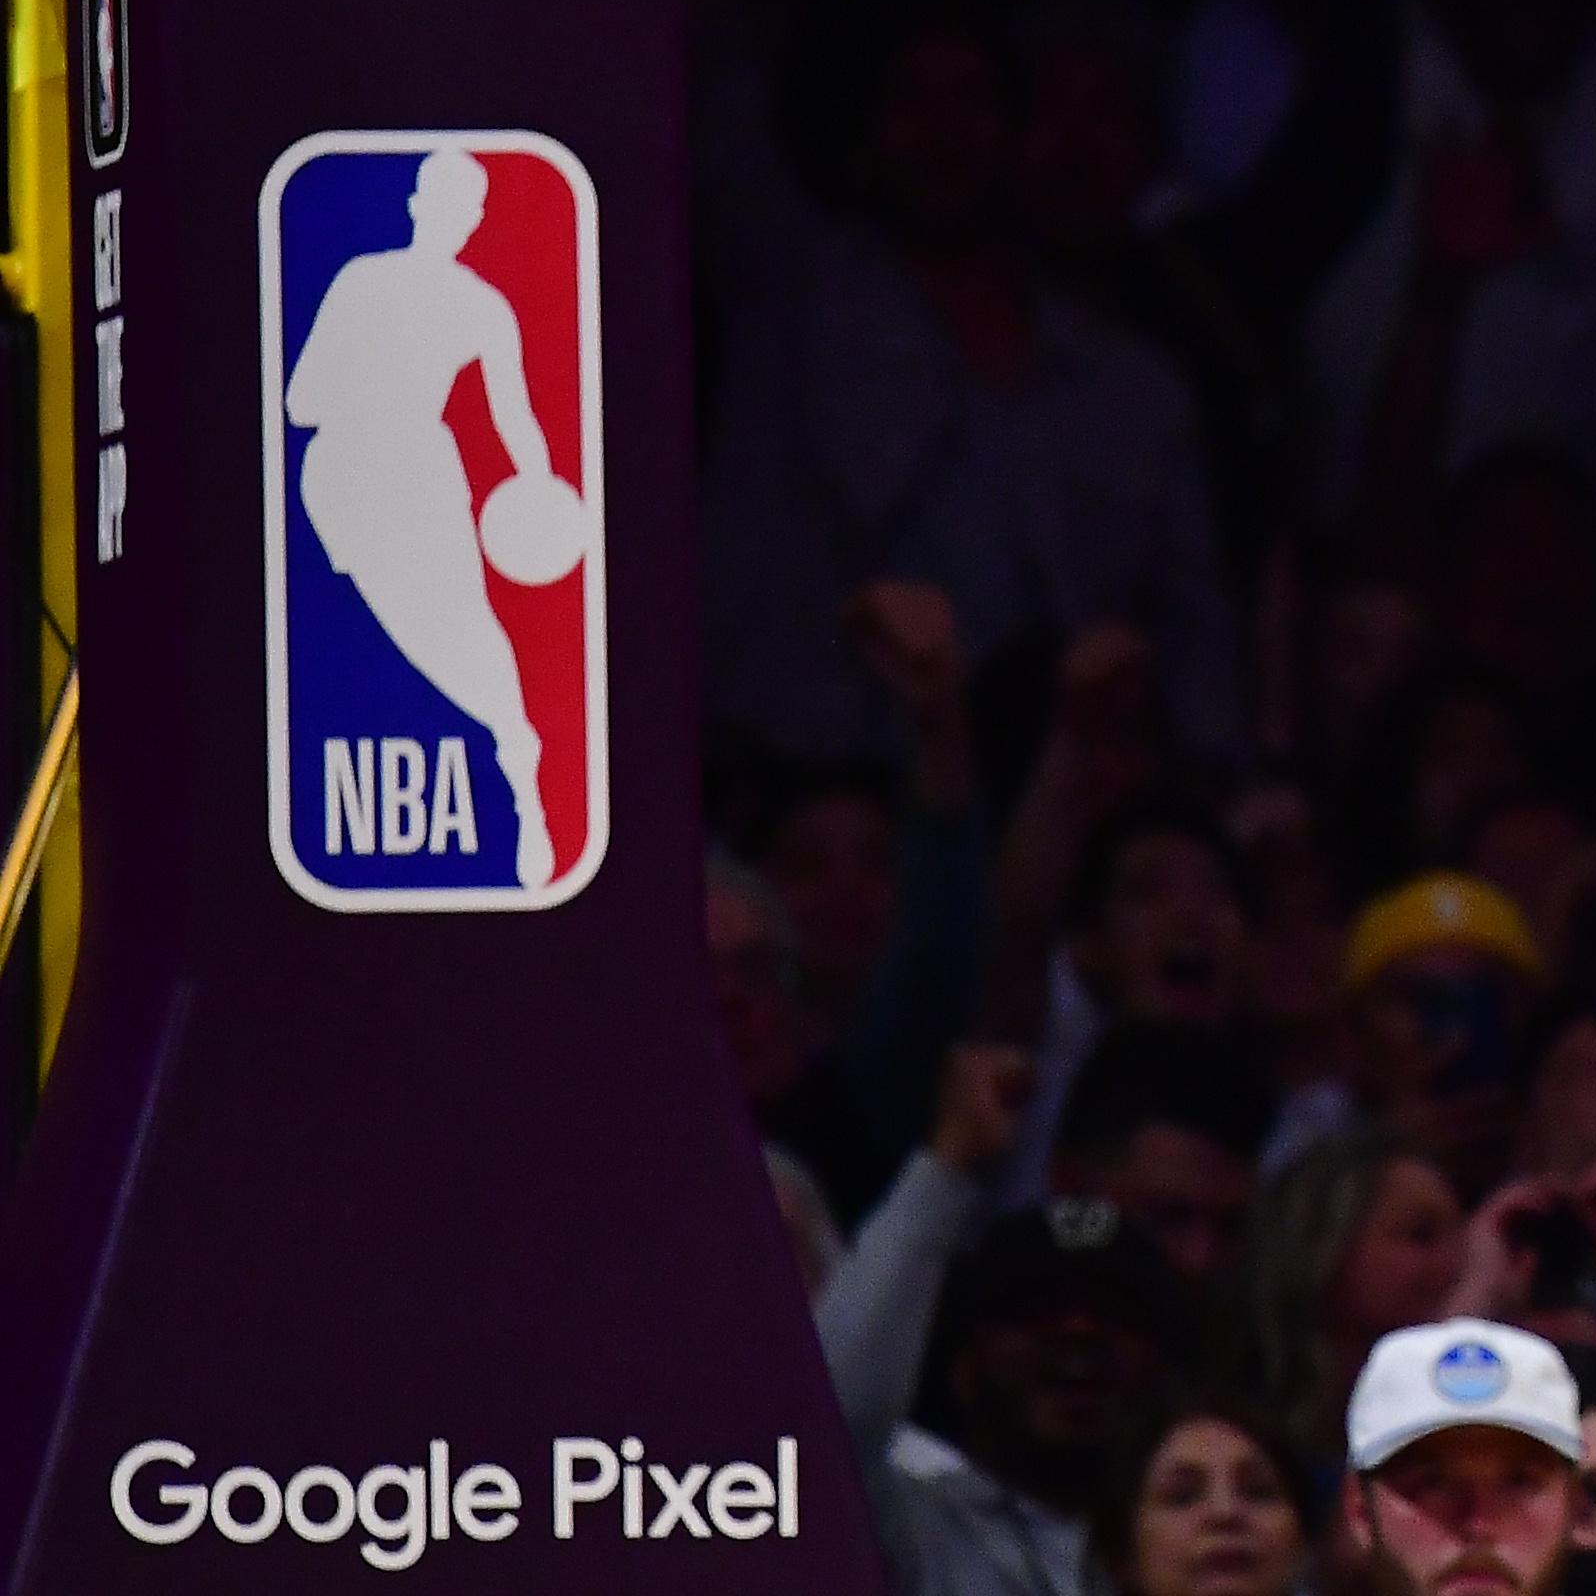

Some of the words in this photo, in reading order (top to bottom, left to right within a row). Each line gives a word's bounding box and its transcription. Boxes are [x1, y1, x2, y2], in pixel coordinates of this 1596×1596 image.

[323, 735, 480, 857] NBA
[109, 1435, 524, 1574] Google
[551, 1434, 801, 1542] Pixel
